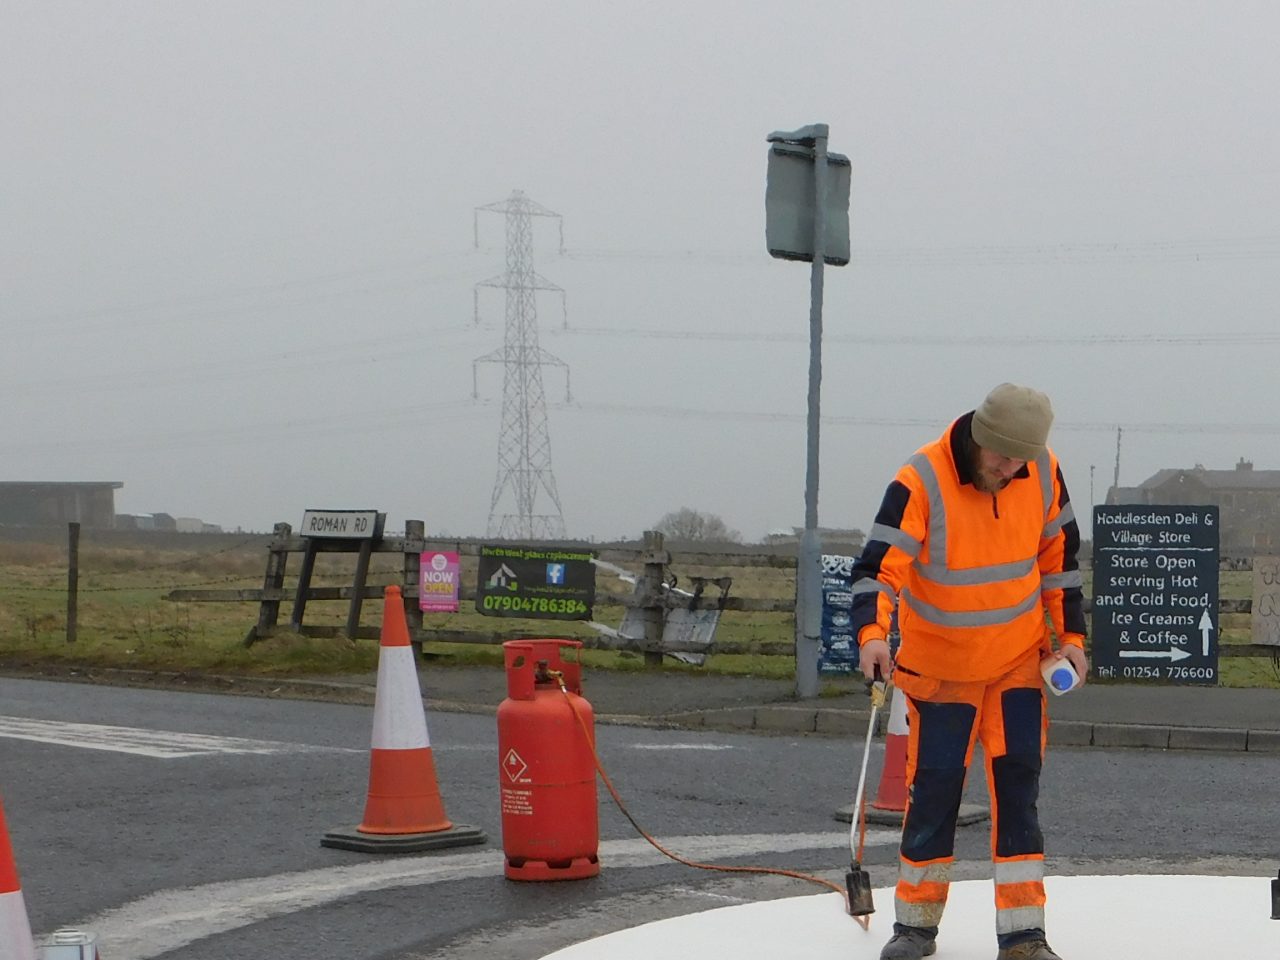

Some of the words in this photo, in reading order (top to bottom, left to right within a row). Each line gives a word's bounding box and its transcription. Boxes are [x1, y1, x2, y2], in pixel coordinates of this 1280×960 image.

[310, 516, 348, 532] ROMAN
[354, 517, 368, 532] RD
[1097, 512, 1171, 525] Hoddlesden
[1175, 513, 1198, 524] Deli
[1204, 514, 1213, 525] &
[1111, 531, 1153, 545] Village
[1159, 531, 1191, 543] Store
[1111, 555, 1149, 568] Store
[1156, 555, 1196, 571] Open
[424, 572, 453, 583] NOW
[1110, 575, 1165, 590] serving
[1171, 575, 1198, 587] Hot
[424, 583, 453, 594] OPEN
[483, 595, 587, 613] 07904786384
[1096, 593, 1124, 605] and
[1130, 593, 1163, 606] Cold
[1171, 594, 1212, 607] Food,
[1111, 612, 1133, 624] Ice
[1139, 612, 1194, 625] Creams
[1120, 631, 1130, 643] &
[1138, 631, 1188, 645] Coffee
[1098, 666, 1117, 678] Tel:
[1123, 666, 1160, 678] 01254
[1166, 667, 1213, 679] 776600
